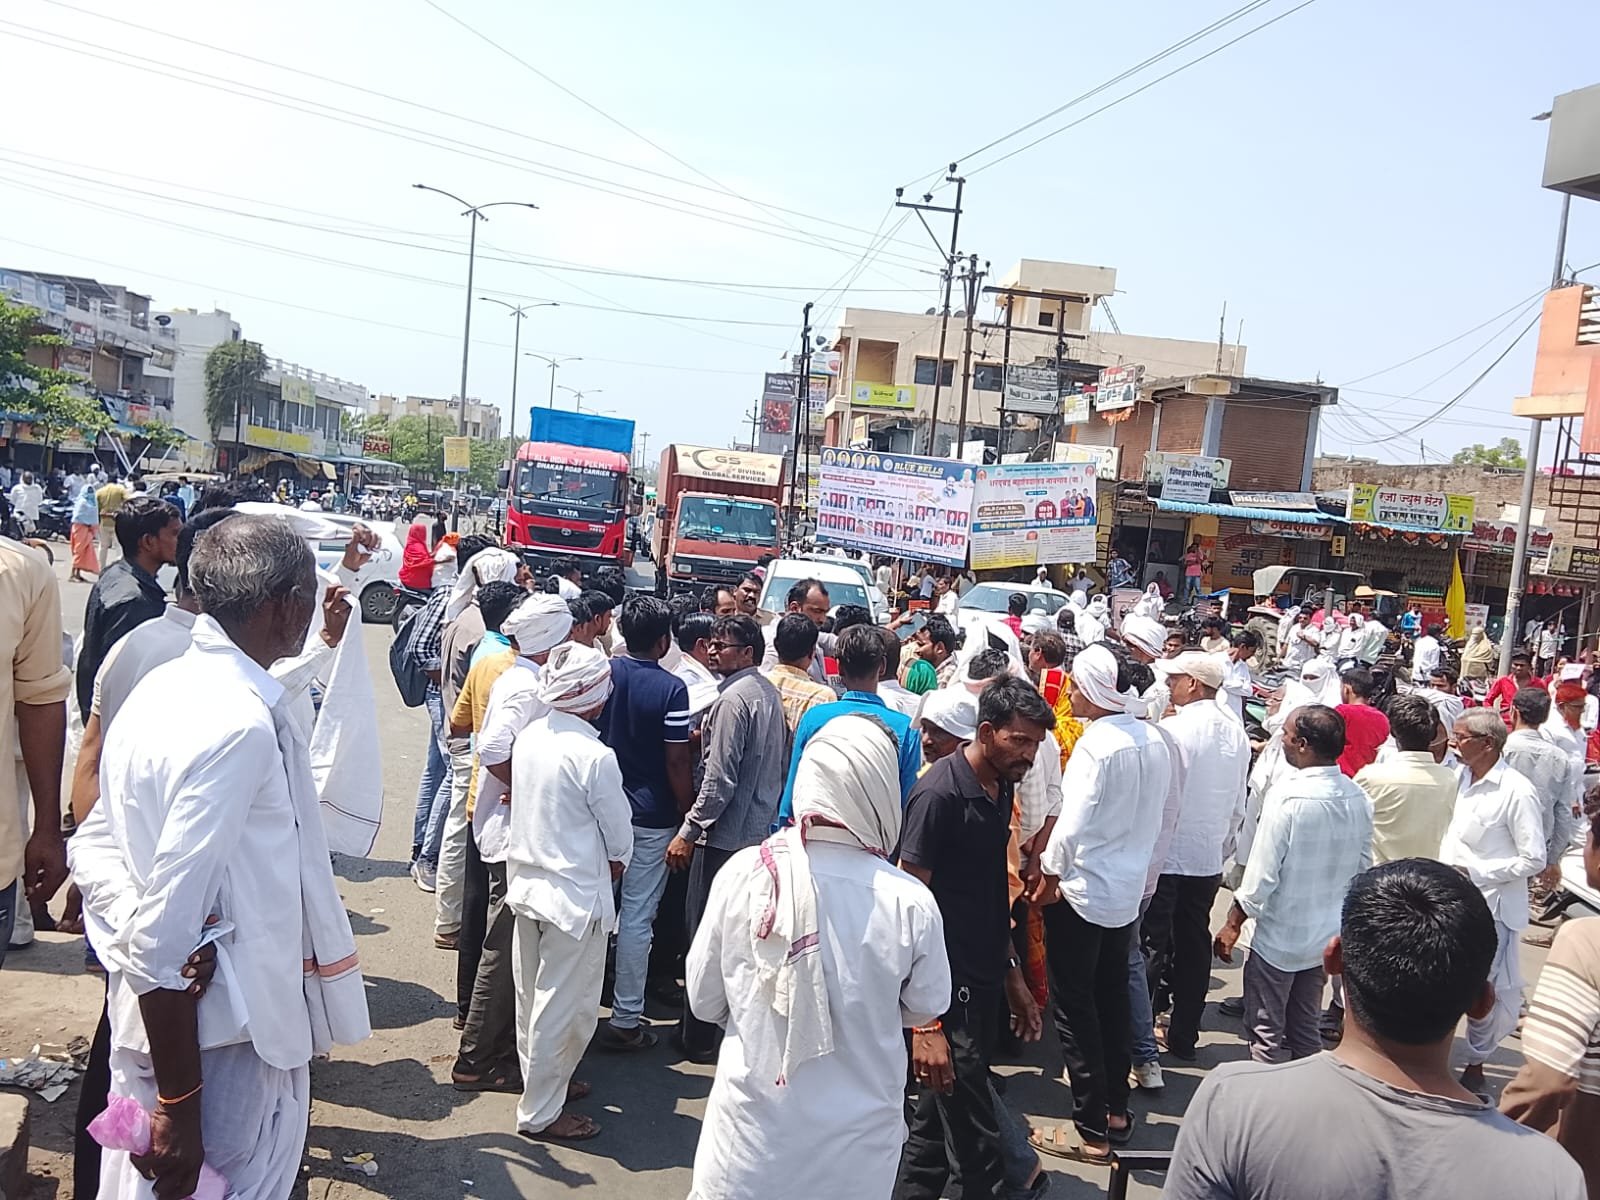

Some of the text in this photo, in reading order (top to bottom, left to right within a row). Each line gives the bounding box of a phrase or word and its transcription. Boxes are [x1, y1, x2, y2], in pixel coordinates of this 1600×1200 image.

[364, 442, 389, 453] BAR
[715, 455, 741, 465] GS
[894, 463, 916, 472] BLUE
[583, 468, 610, 477] CARRIER
[702, 470, 766, 483] GLOBAL SERVICES
[557, 509, 579, 517] TATA
